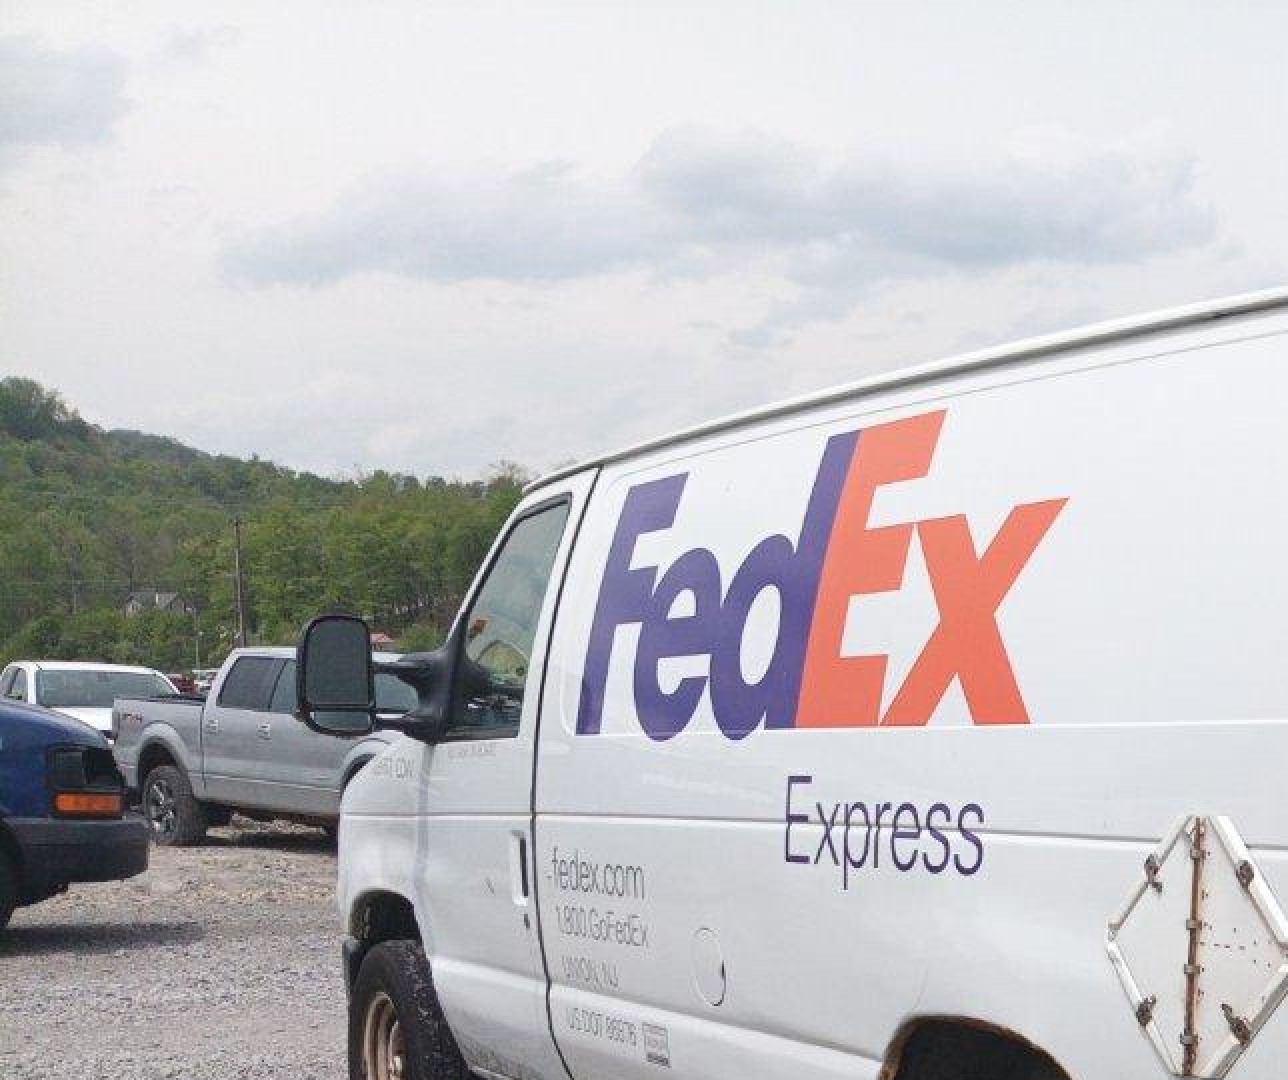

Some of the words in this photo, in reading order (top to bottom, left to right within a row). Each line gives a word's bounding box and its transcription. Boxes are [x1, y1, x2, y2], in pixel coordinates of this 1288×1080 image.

[576, 409, 1070, 742] FedEx
[551, 846, 645, 899] fedex.com
[784, 775, 984, 889] Express
